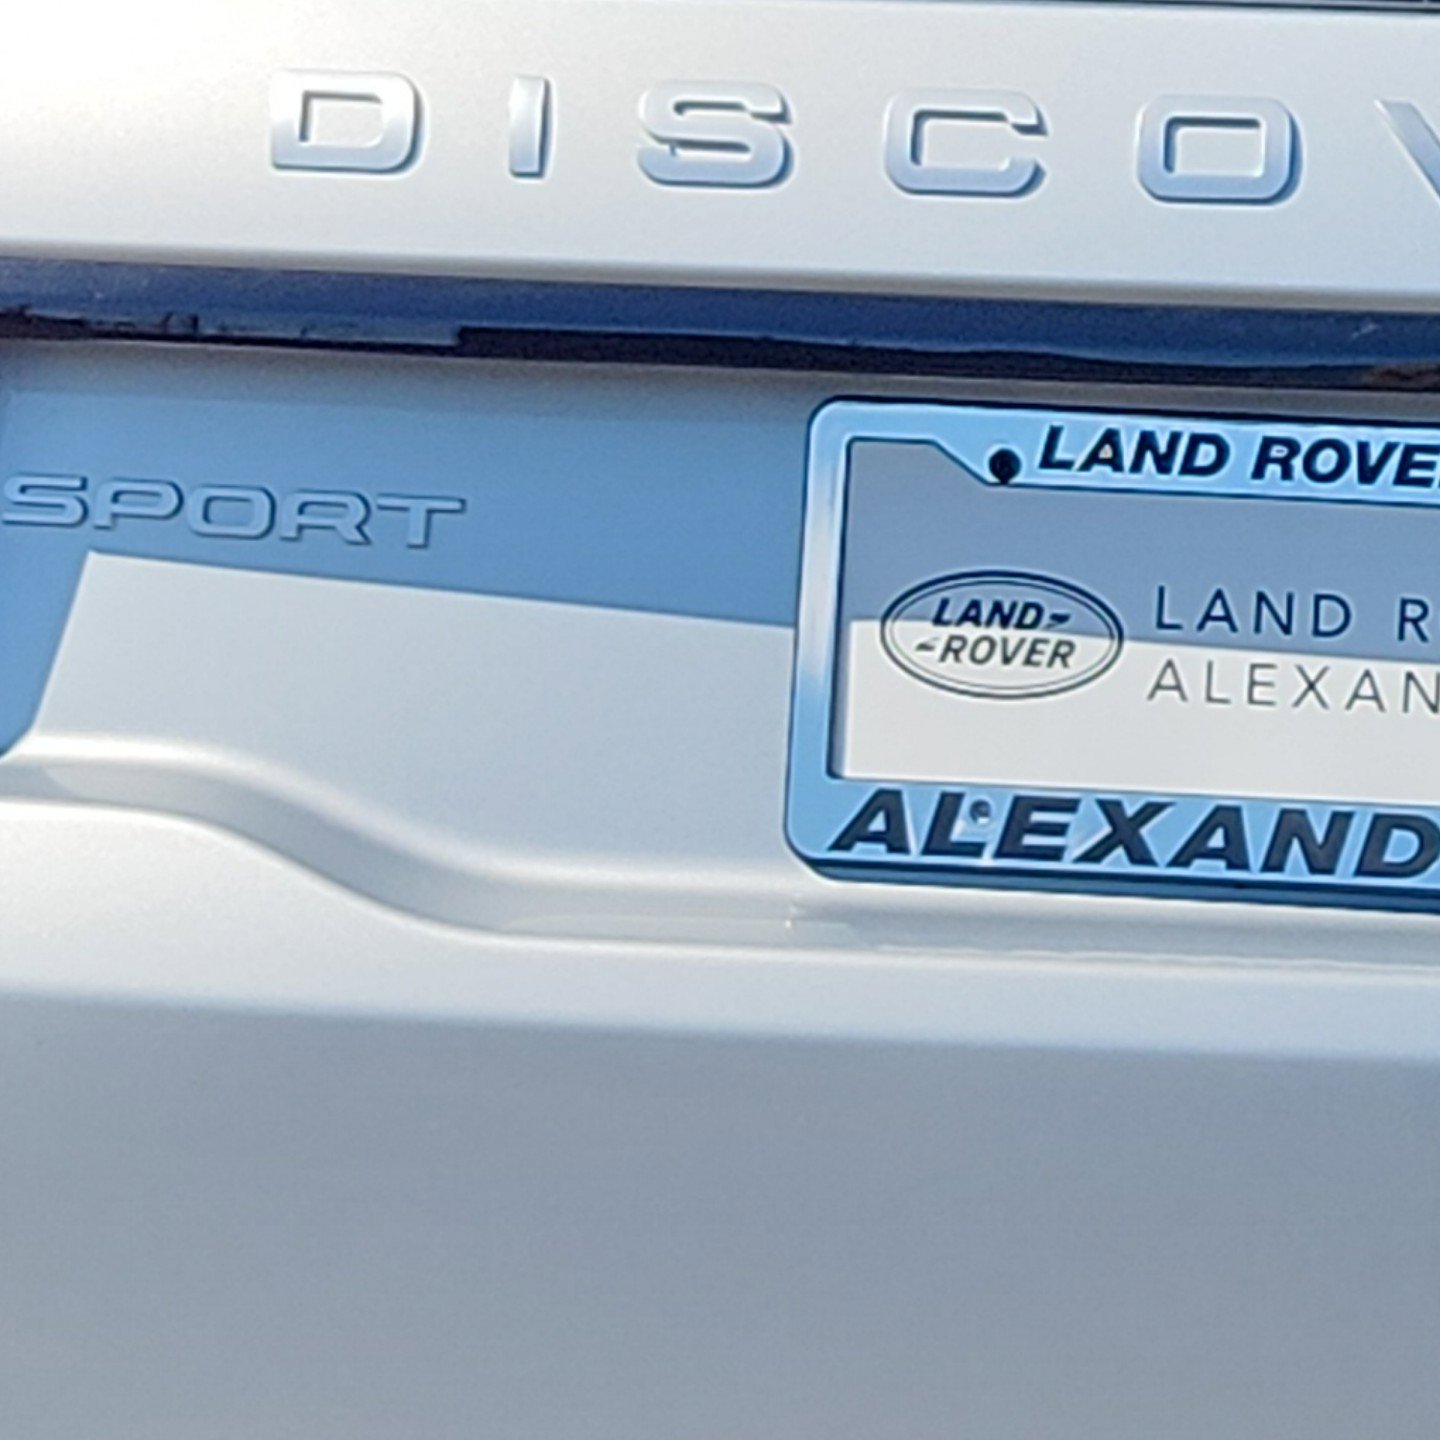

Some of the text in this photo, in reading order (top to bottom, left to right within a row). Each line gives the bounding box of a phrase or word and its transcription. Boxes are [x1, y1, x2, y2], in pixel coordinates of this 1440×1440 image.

[1038, 425, 1231, 480] LAND
[1, 472, 467, 549] SPORT
[932, 596, 1043, 631] LAND
[1155, 585, 1353, 639] LAND
[938, 636, 1076, 670] ROVER
